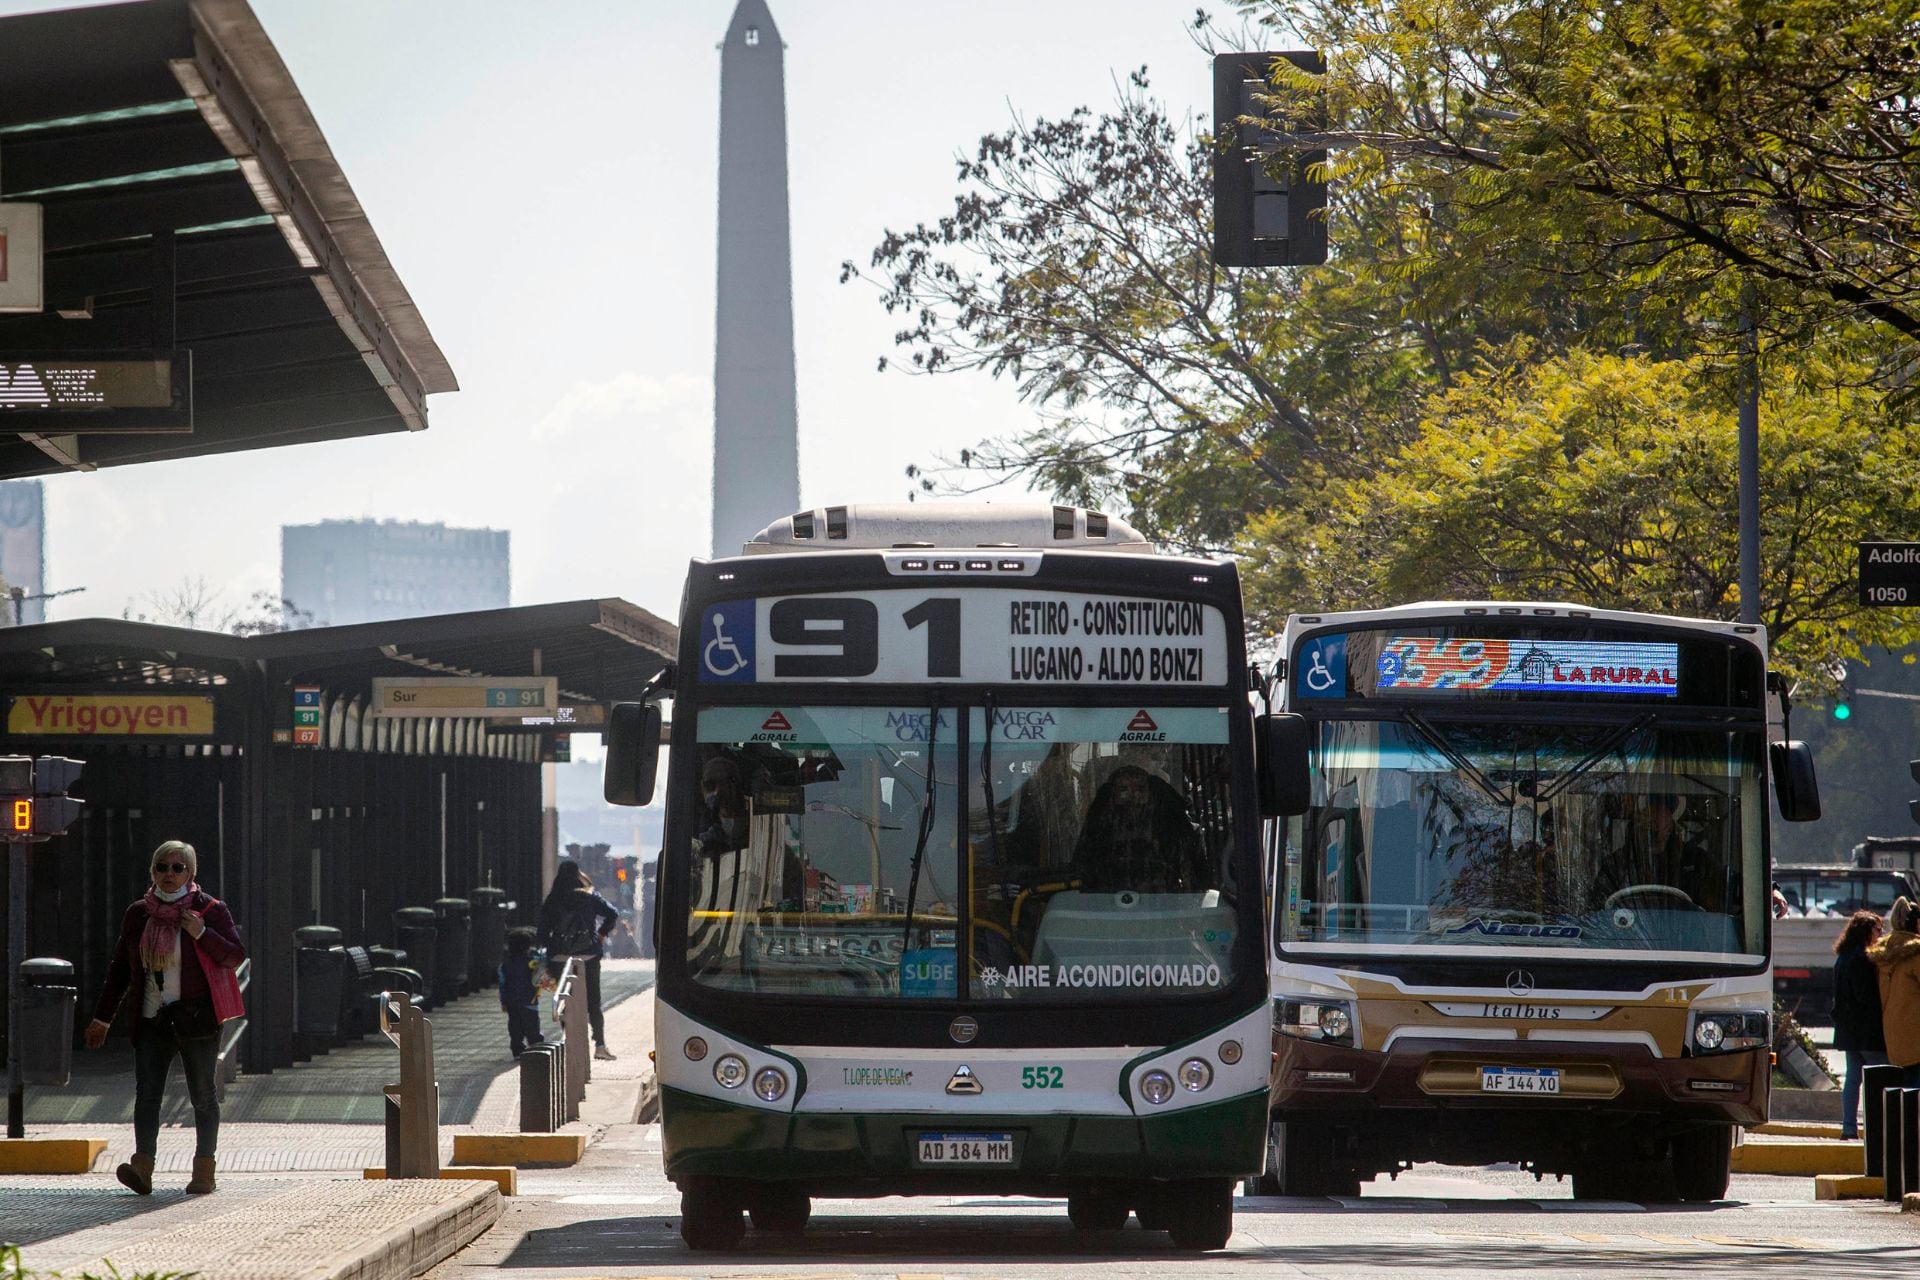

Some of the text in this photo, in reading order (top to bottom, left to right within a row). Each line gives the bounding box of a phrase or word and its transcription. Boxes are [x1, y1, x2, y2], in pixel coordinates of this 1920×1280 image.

[1867, 587, 1907, 601] 1050
[1011, 601, 1069, 635] RETIRO
[770, 598, 961, 677] 91
[1011, 646, 1082, 680] LUGANO
[1098, 647, 1144, 681] ALDO
[1150, 648, 1203, 681] BONZI
[1553, 666, 1678, 685] LA RURAL
[393, 690, 417, 703] Sur
[496, 691, 506, 706] 9
[521, 690, 539, 706] 91
[27, 697, 188, 734] Yrigoyen
[302, 712, 315, 722] 91
[992, 709, 1057, 728] MEGA
[301, 731, 315, 742] 67
[750, 733, 798, 742] AGRALE
[1003, 724, 1046, 740] CAR
[1119, 732, 1167, 742] AGRALE
[14, 800, 30, 831] 8
[905, 963, 954, 981] SUBE
[1005, 964, 1220, 988] AIRE ACONDICIONADO
[1483, 1003, 1561, 1018] Italbus
[1022, 1066, 1064, 1089] 552
[1486, 1076, 1502, 1088] AF
[1508, 1077, 1534, 1090] 144
[923, 1143, 1009, 1160] AD 184 MM
